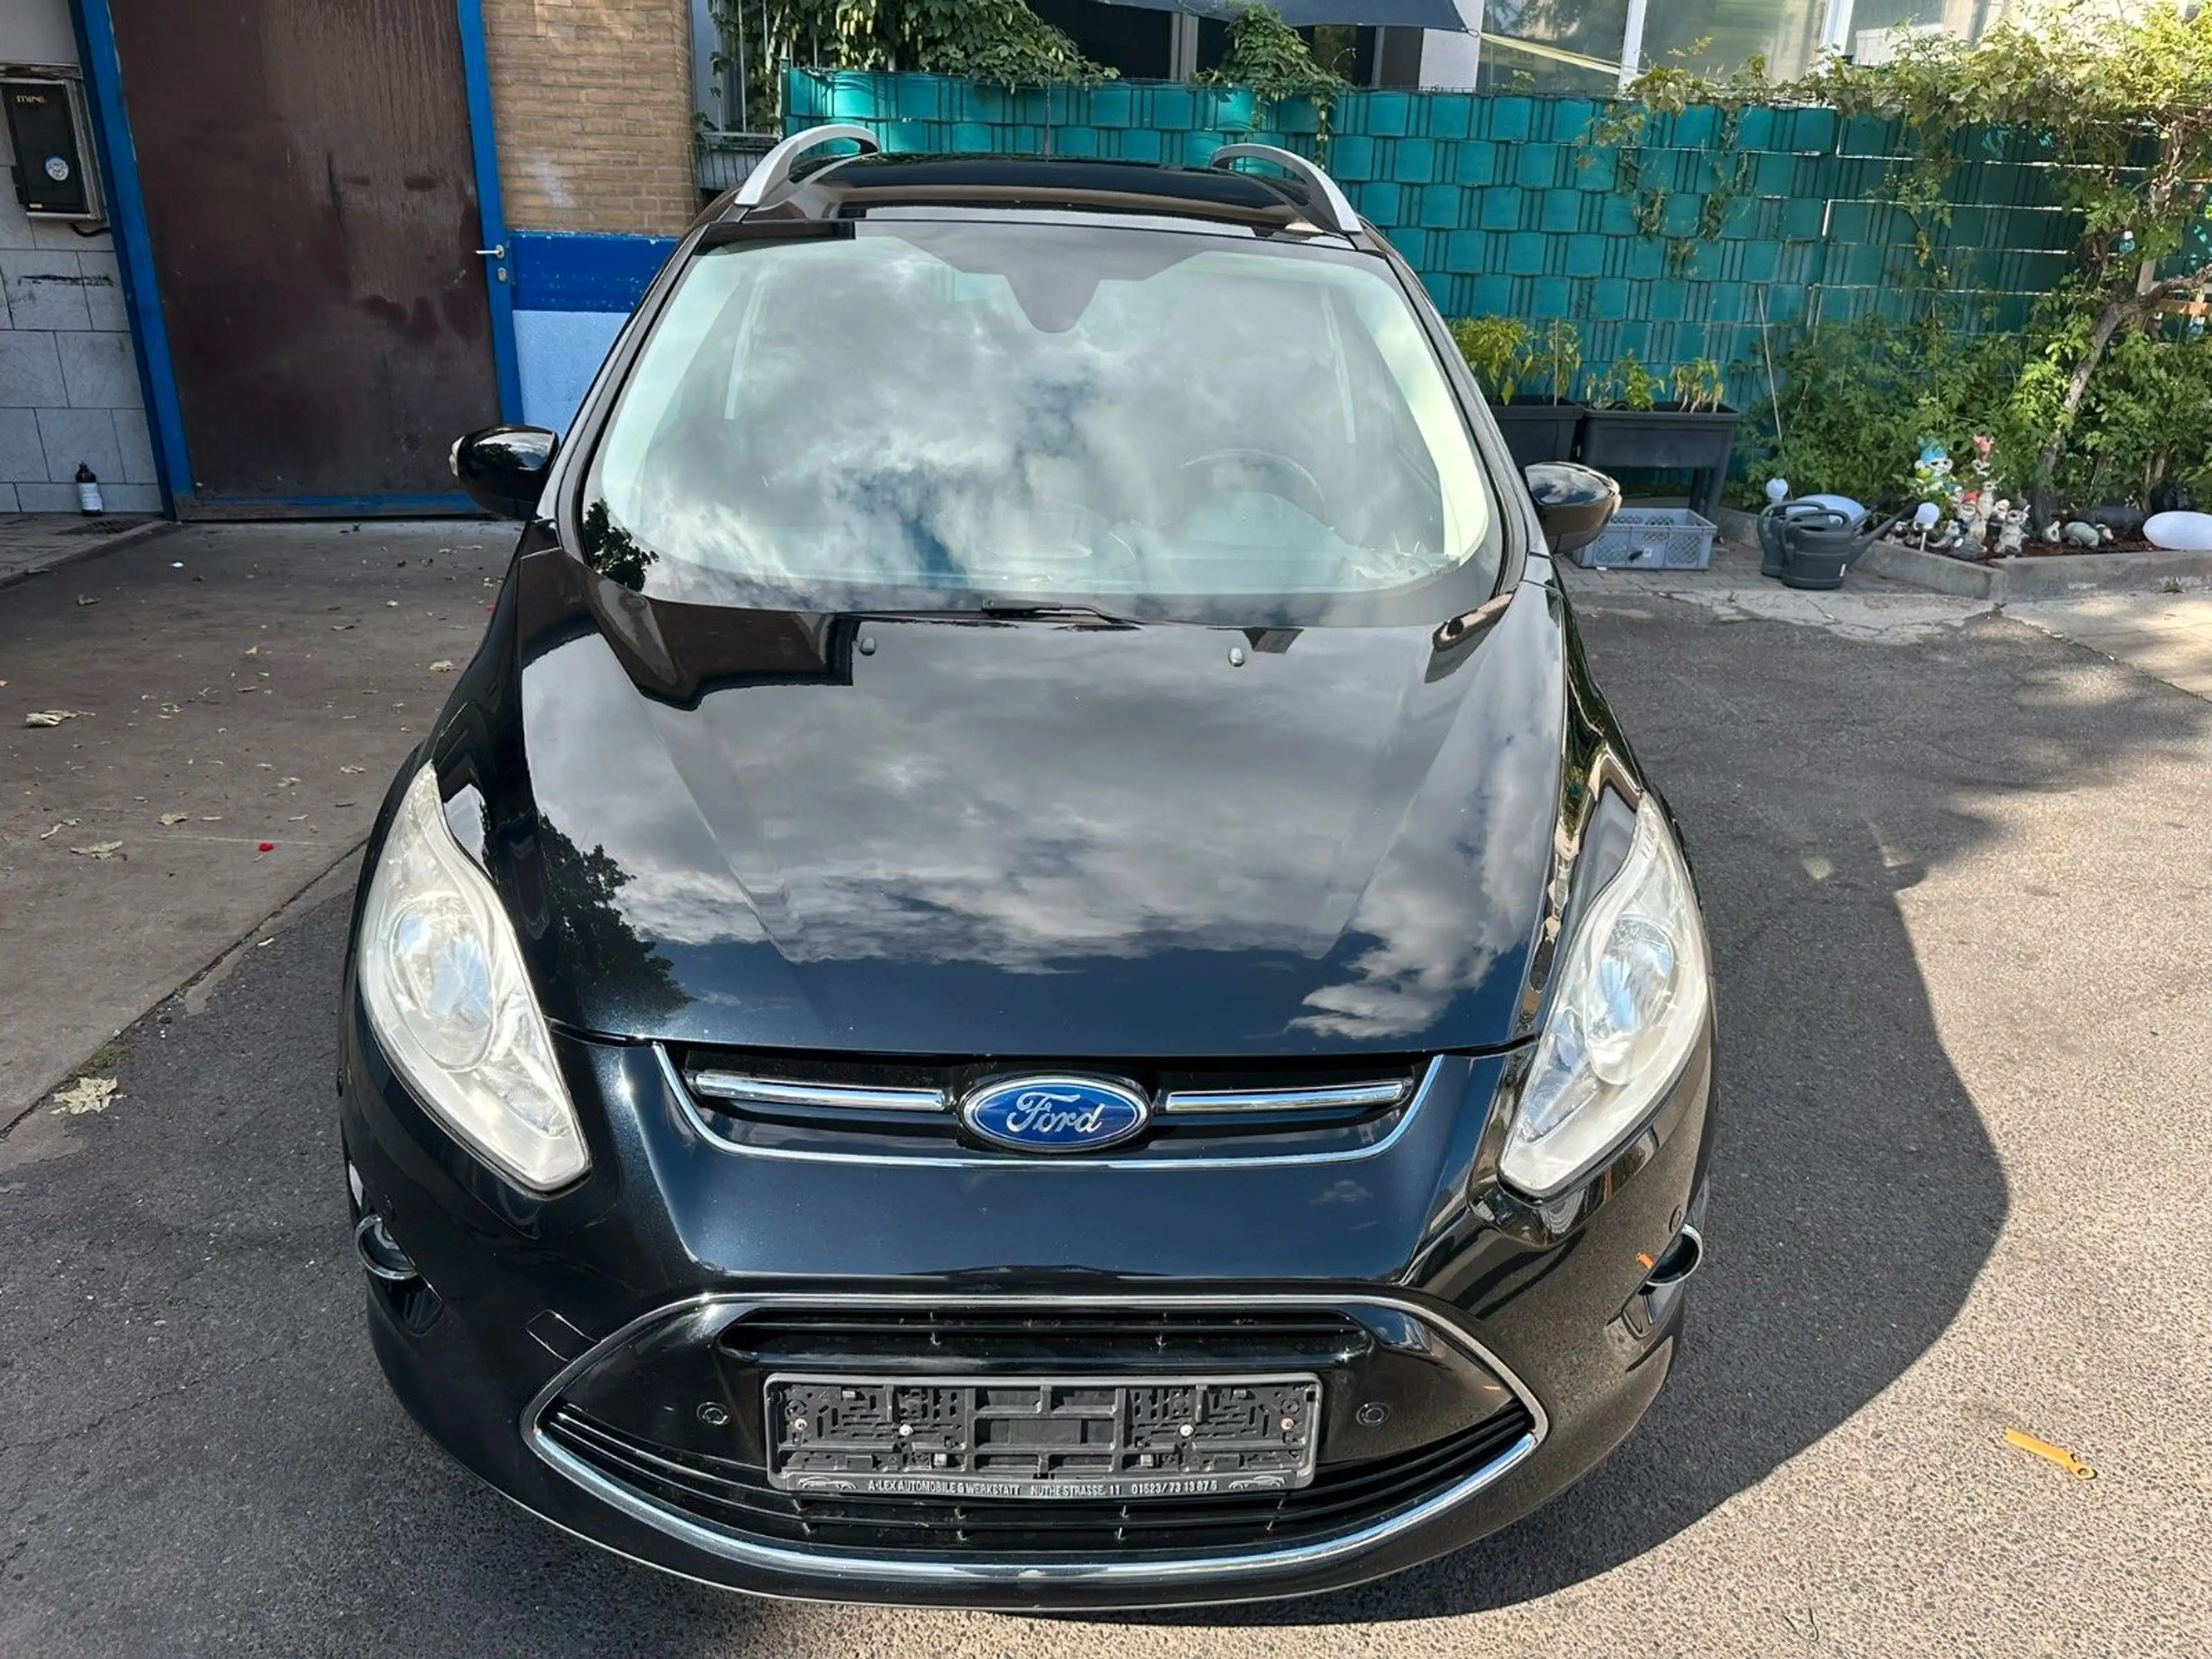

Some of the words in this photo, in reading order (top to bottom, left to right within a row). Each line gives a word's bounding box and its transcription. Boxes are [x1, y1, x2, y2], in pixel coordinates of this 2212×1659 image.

[1006, 1092, 1105, 1133] Ford
[897, 1480, 956, 1493] AUTOMOBILE
[965, 1483, 1021, 1495] WERKSTATT
